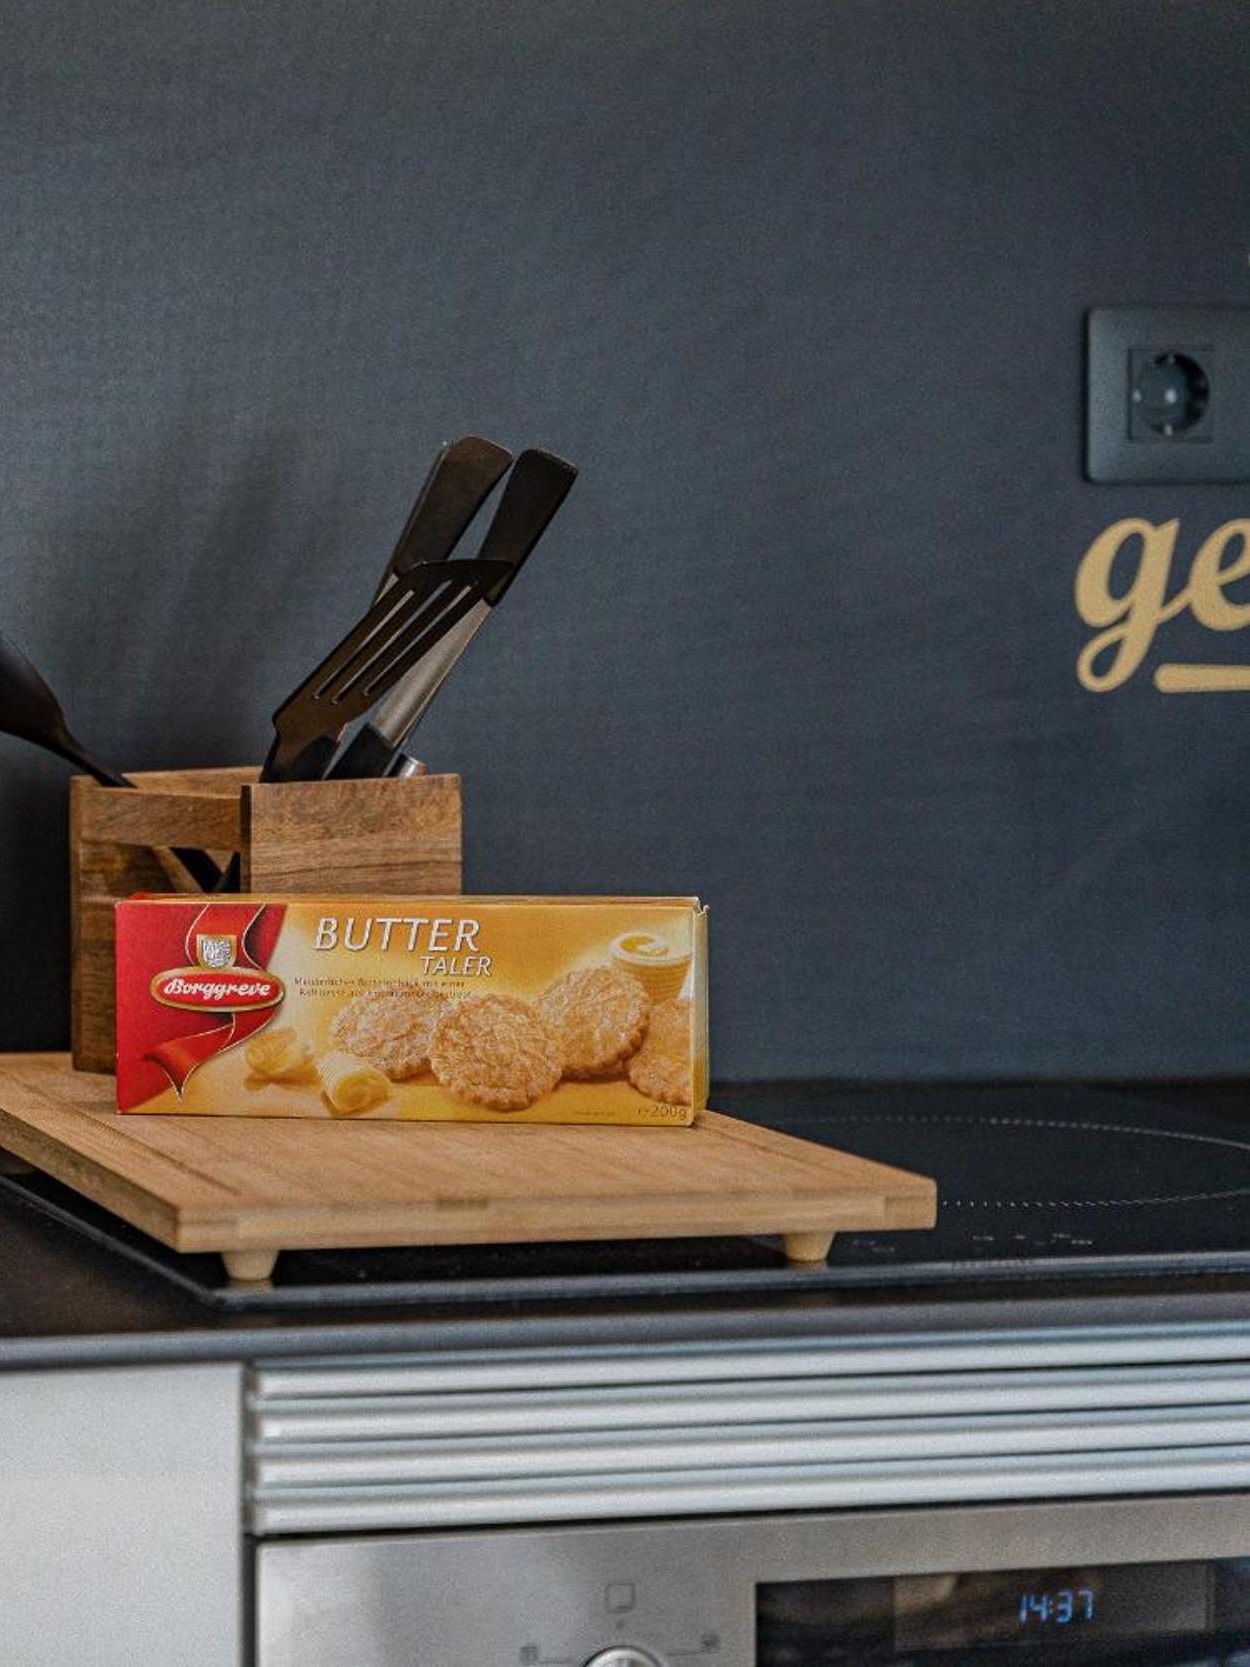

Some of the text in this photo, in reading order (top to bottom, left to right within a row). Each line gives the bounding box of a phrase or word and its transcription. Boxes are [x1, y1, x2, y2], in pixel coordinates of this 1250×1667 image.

[1075, 517, 1250, 693] ge
[315, 917, 480, 952] BUTTER
[420, 956, 492, 976] TALER
[163, 978, 271, 1000] Borggreve
[1018, 1589, 1093, 1624] 14:37
